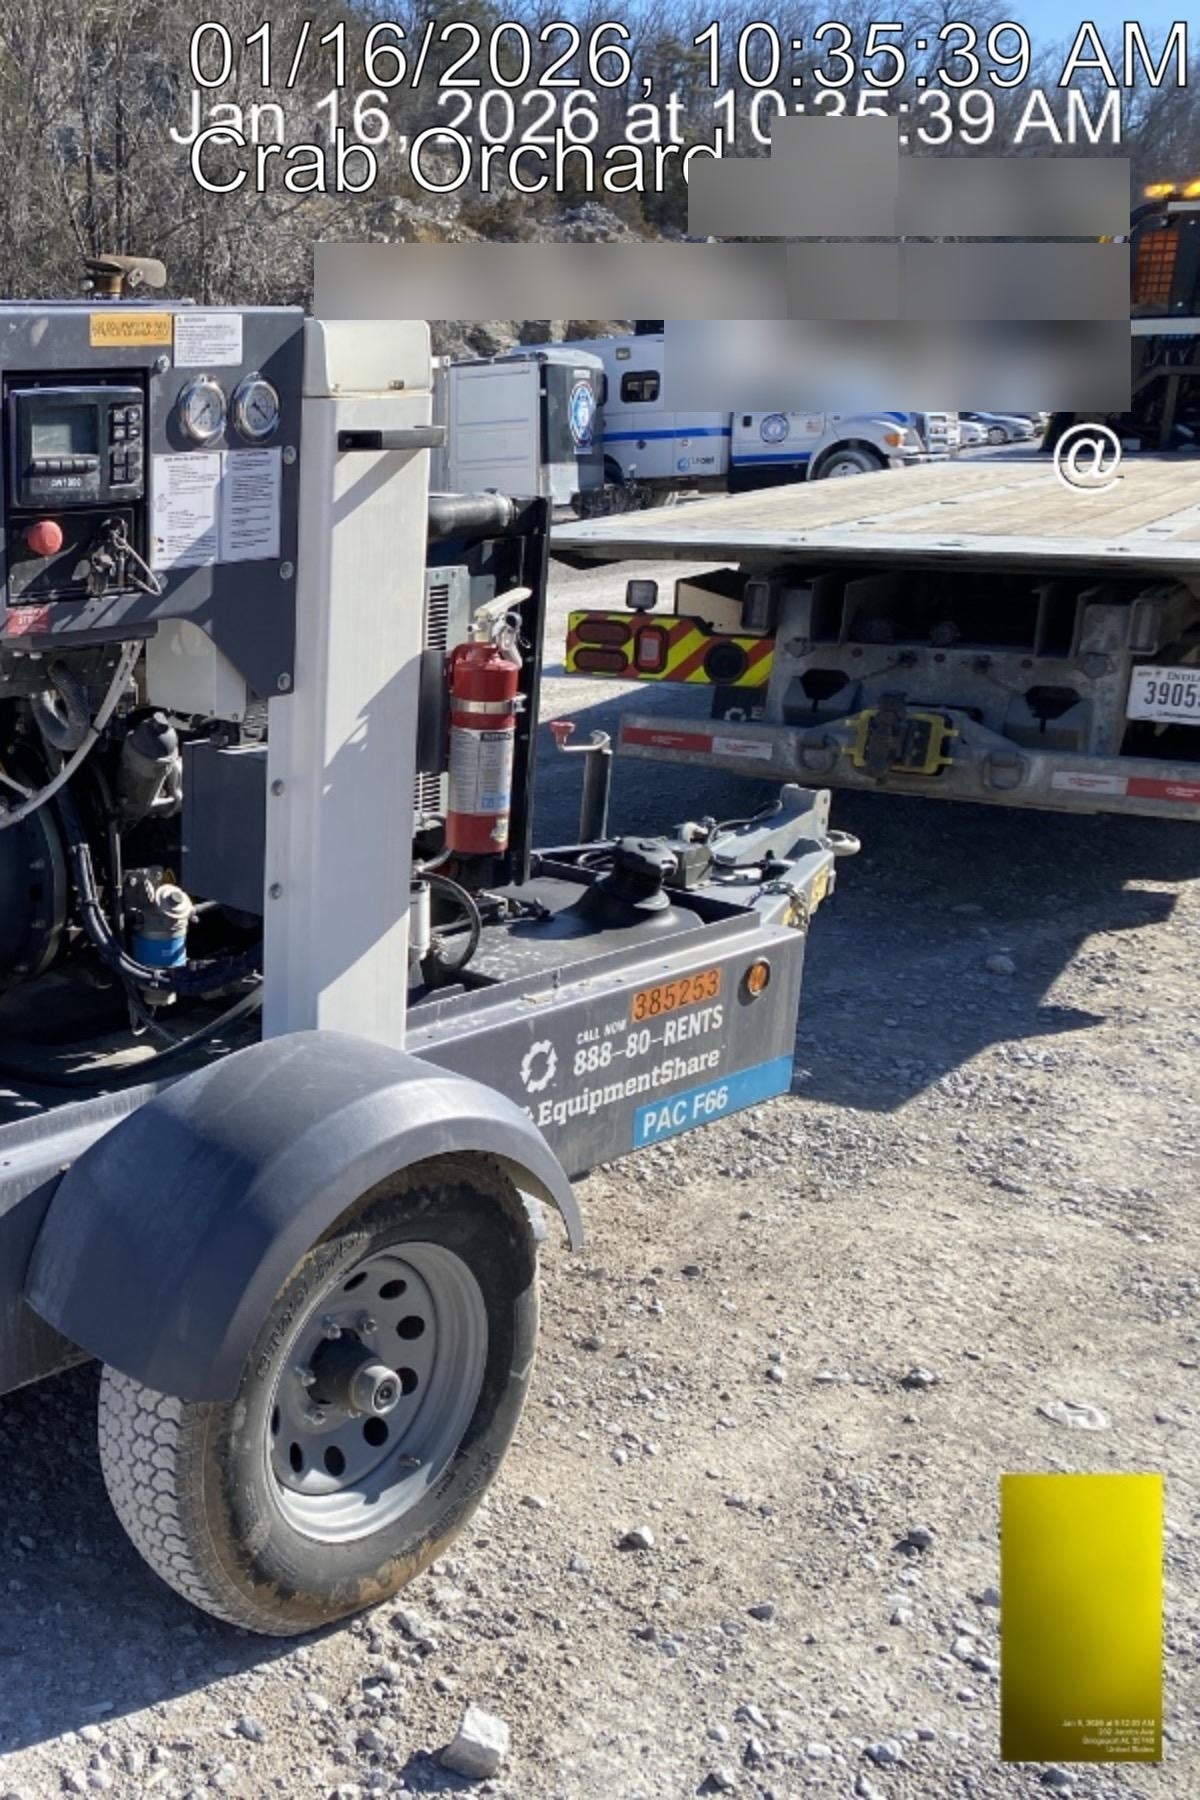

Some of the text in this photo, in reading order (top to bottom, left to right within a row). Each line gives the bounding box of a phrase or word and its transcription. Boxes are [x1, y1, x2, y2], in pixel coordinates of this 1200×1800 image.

[1144, 681, 1200, 708] 3905
[634, 970, 719, 1021] 385253
[573, 1005, 724, 1077] 888-80-RENTS
[577, 1018, 627, 1045] CALL NOW
[538, 1049, 720, 1127] EquipmentShare
[643, 1086, 729, 1138] PAC F66
